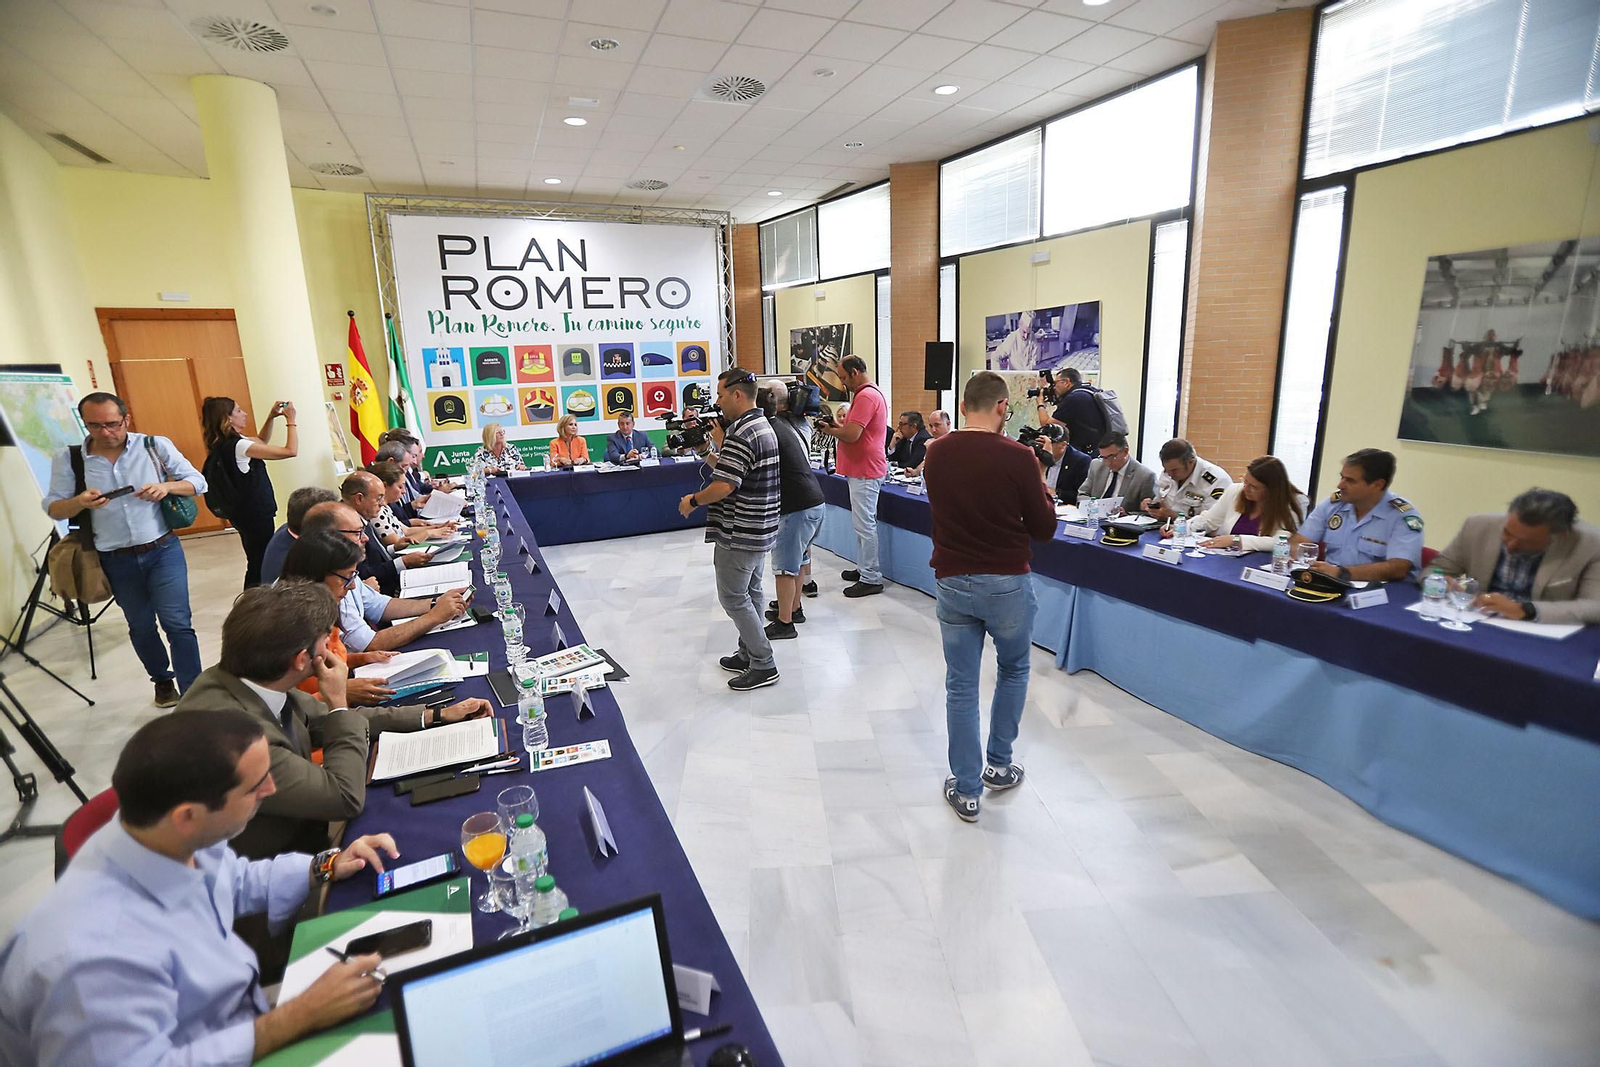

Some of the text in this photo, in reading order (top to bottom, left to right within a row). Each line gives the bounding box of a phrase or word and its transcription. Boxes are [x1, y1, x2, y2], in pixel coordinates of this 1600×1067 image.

[437, 234, 587, 272] PLAN
[442, 275, 691, 310] ROMERO
[427, 310, 703, 338] Plan Romero. Tu camino seguro
